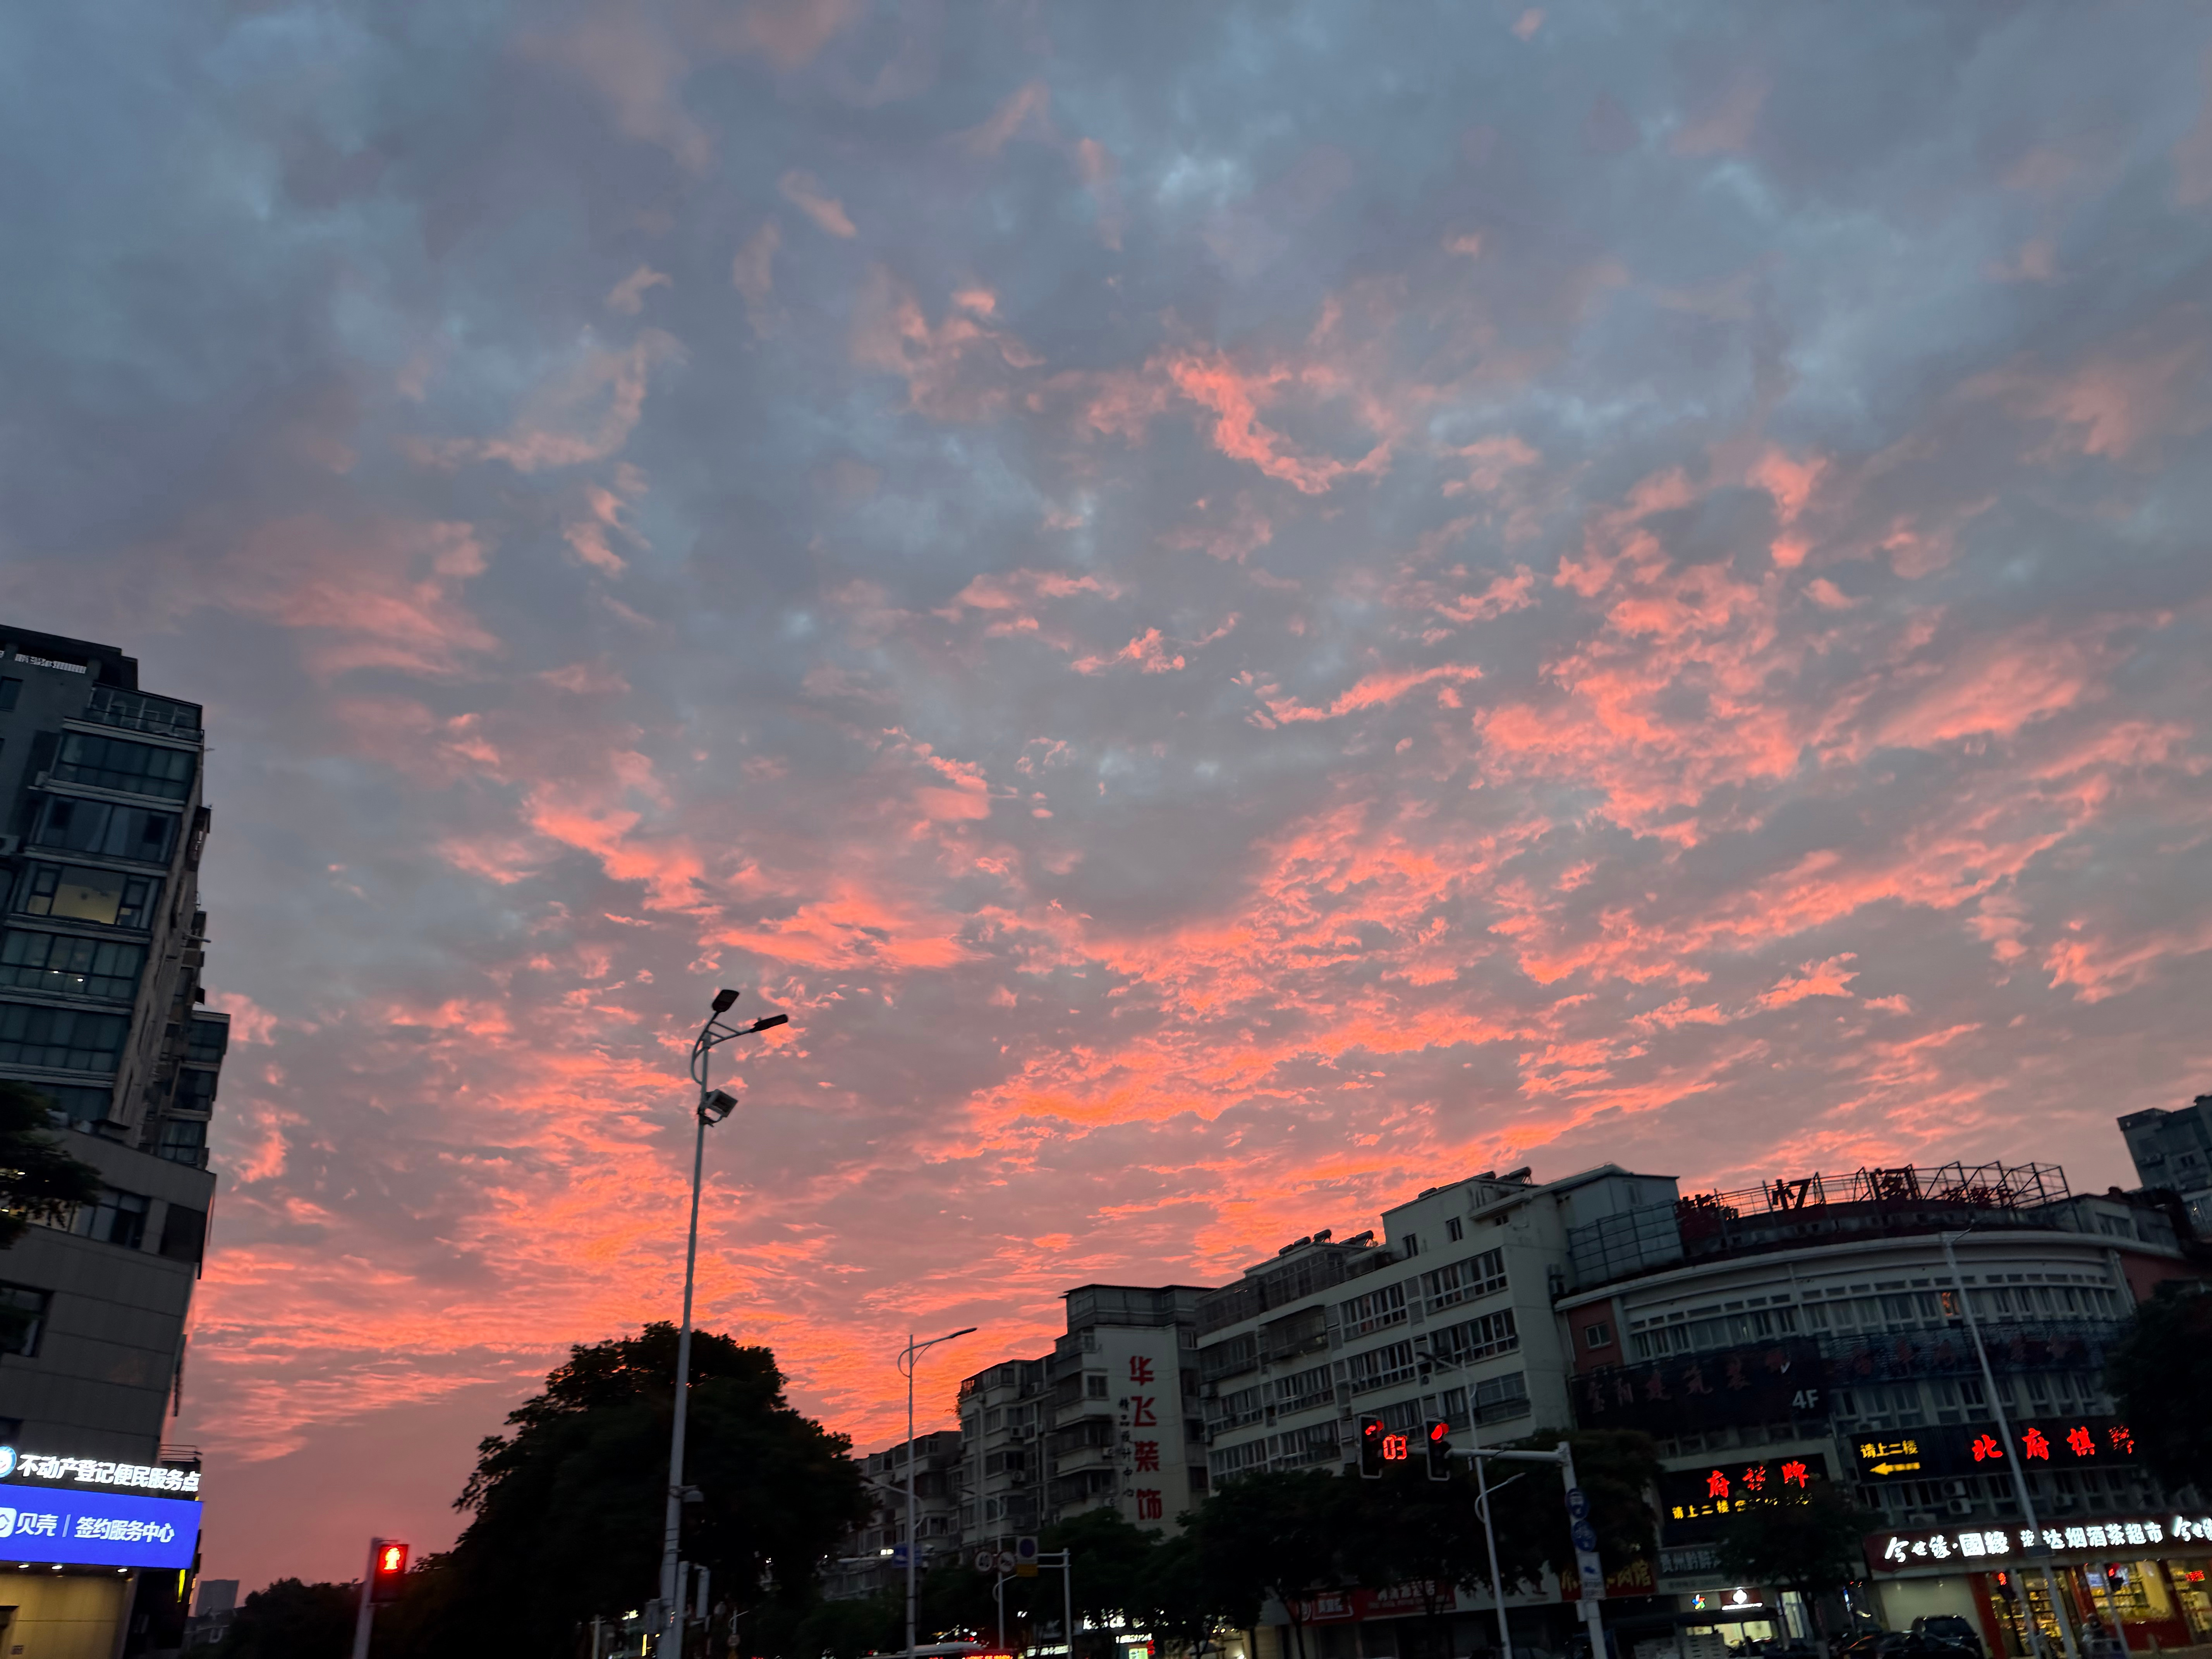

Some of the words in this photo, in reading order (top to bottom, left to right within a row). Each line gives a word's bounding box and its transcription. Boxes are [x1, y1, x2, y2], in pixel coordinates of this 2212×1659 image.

[1792, 1389, 1819, 1409] 4F
[1129, 1356, 1162, 1520] 华飞装饰
[1382, 1434, 1407, 1460] 03
[1860, 1440, 1918, 1458] 请上二楼
[17, 1454, 201, 1492] 不动产登记便民服务点
[15, 1512, 58, 1537] 贝壳
[74, 1516, 175, 1543] 签约服务中心
